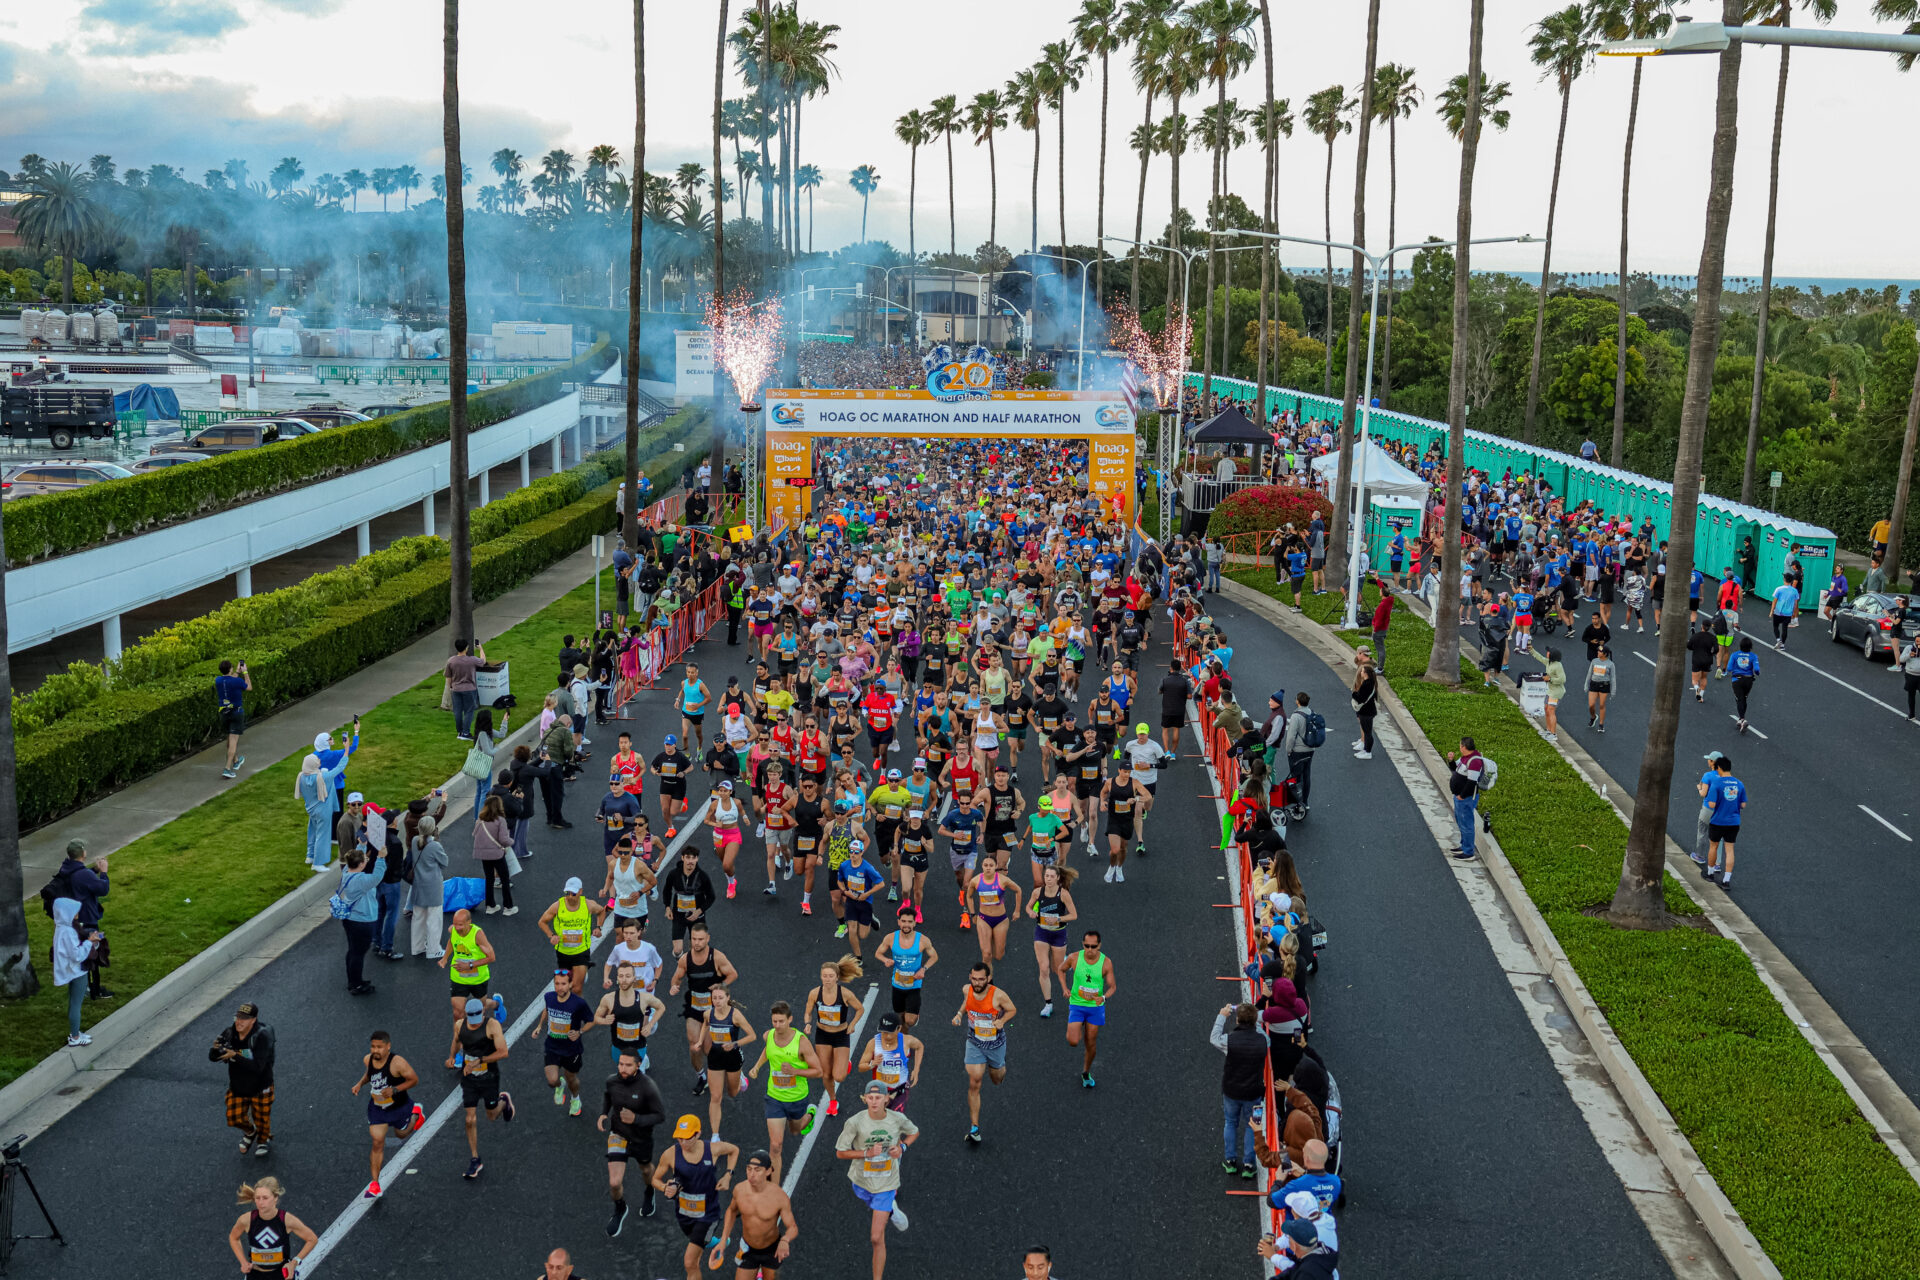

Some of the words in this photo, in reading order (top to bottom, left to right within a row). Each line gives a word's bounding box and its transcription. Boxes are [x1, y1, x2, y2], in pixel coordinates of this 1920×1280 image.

[943, 362, 991, 389] 20
[936, 392, 989, 402] marathon
[819, 412, 856, 422] HOAG
[860, 412, 879, 422] OC
[882, 412, 949, 423] MARATHON
[953, 413, 979, 423] AND
[982, 413, 1010, 423] HALF
[1013, 413, 1081, 424] MARATHON
